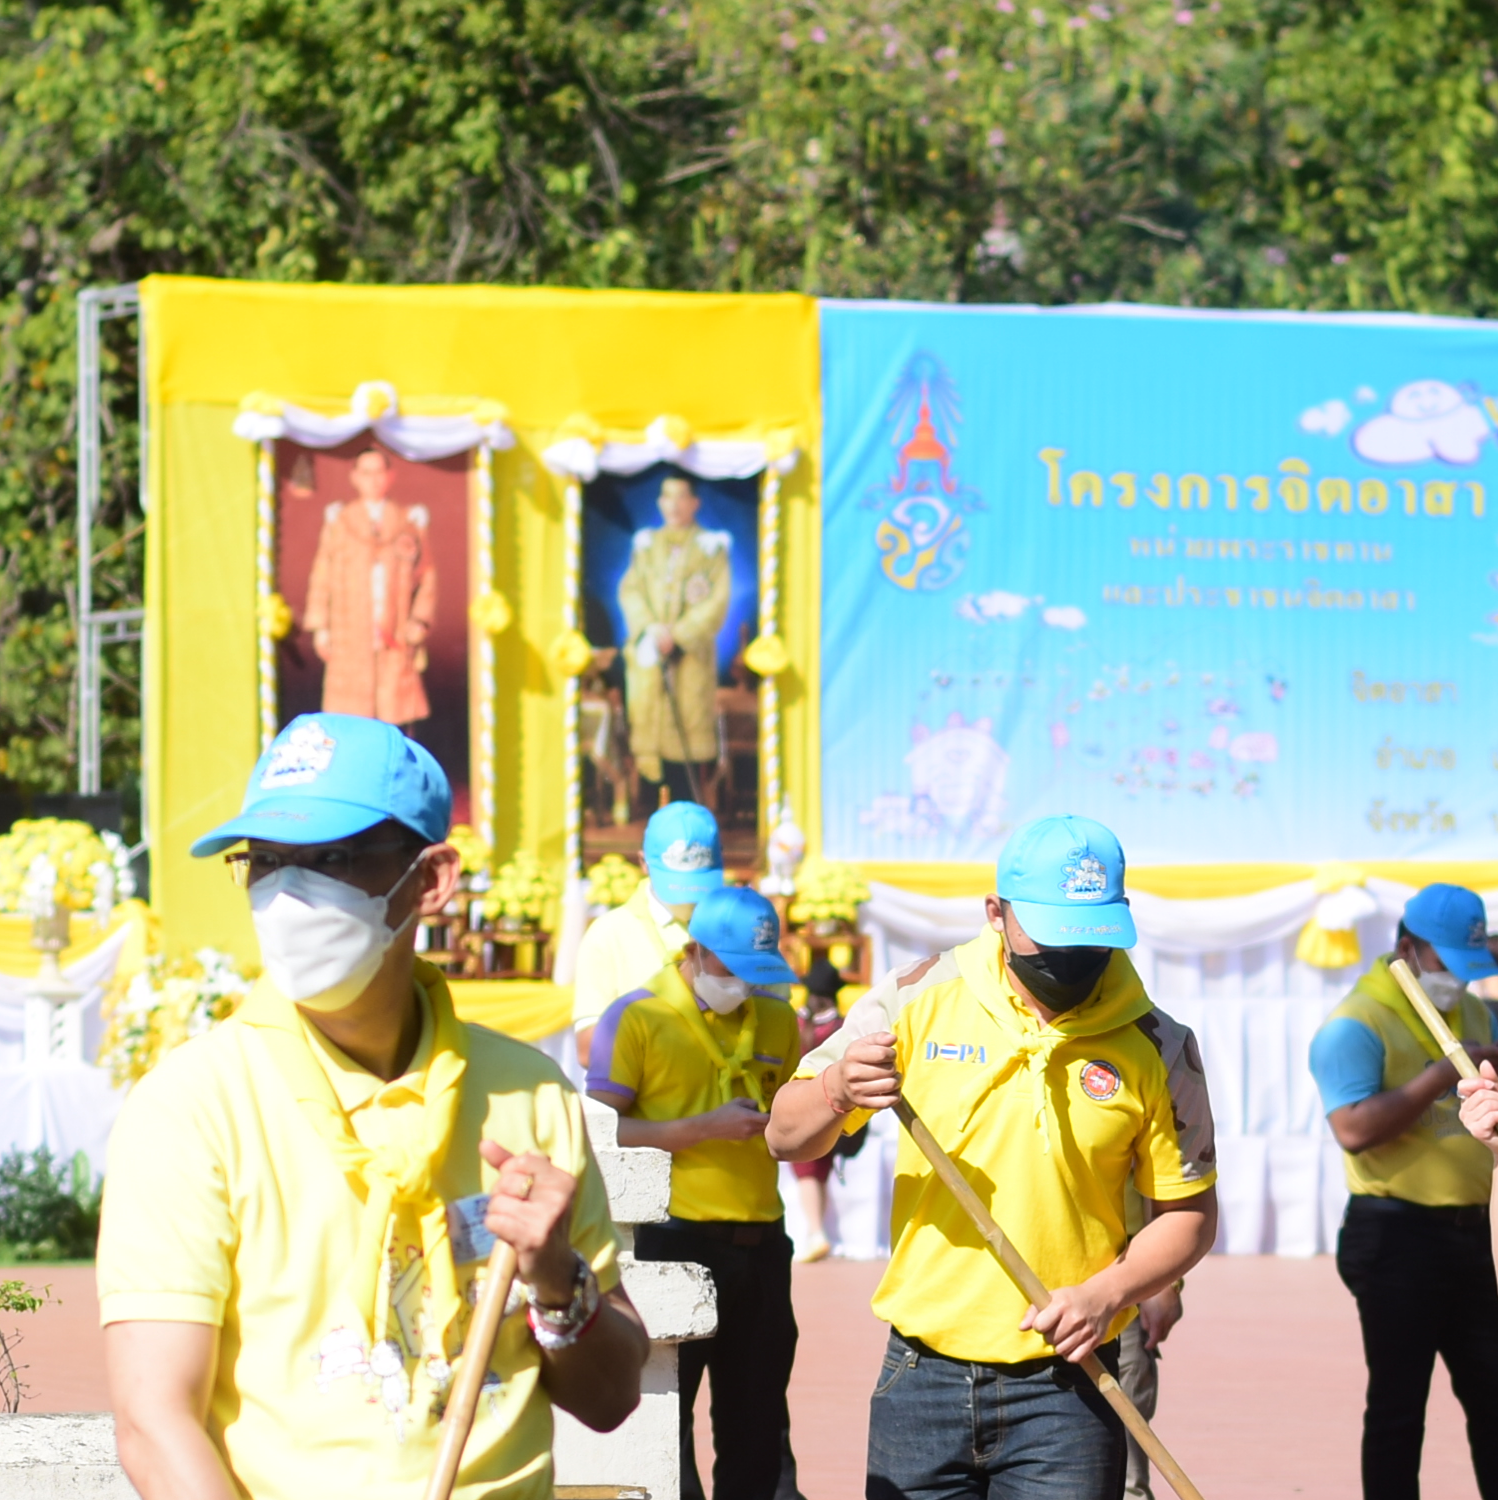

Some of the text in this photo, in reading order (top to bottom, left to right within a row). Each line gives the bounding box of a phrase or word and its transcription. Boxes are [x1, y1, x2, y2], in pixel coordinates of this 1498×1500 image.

[1038, 447, 1486, 518] โครงการจิตอาสา
